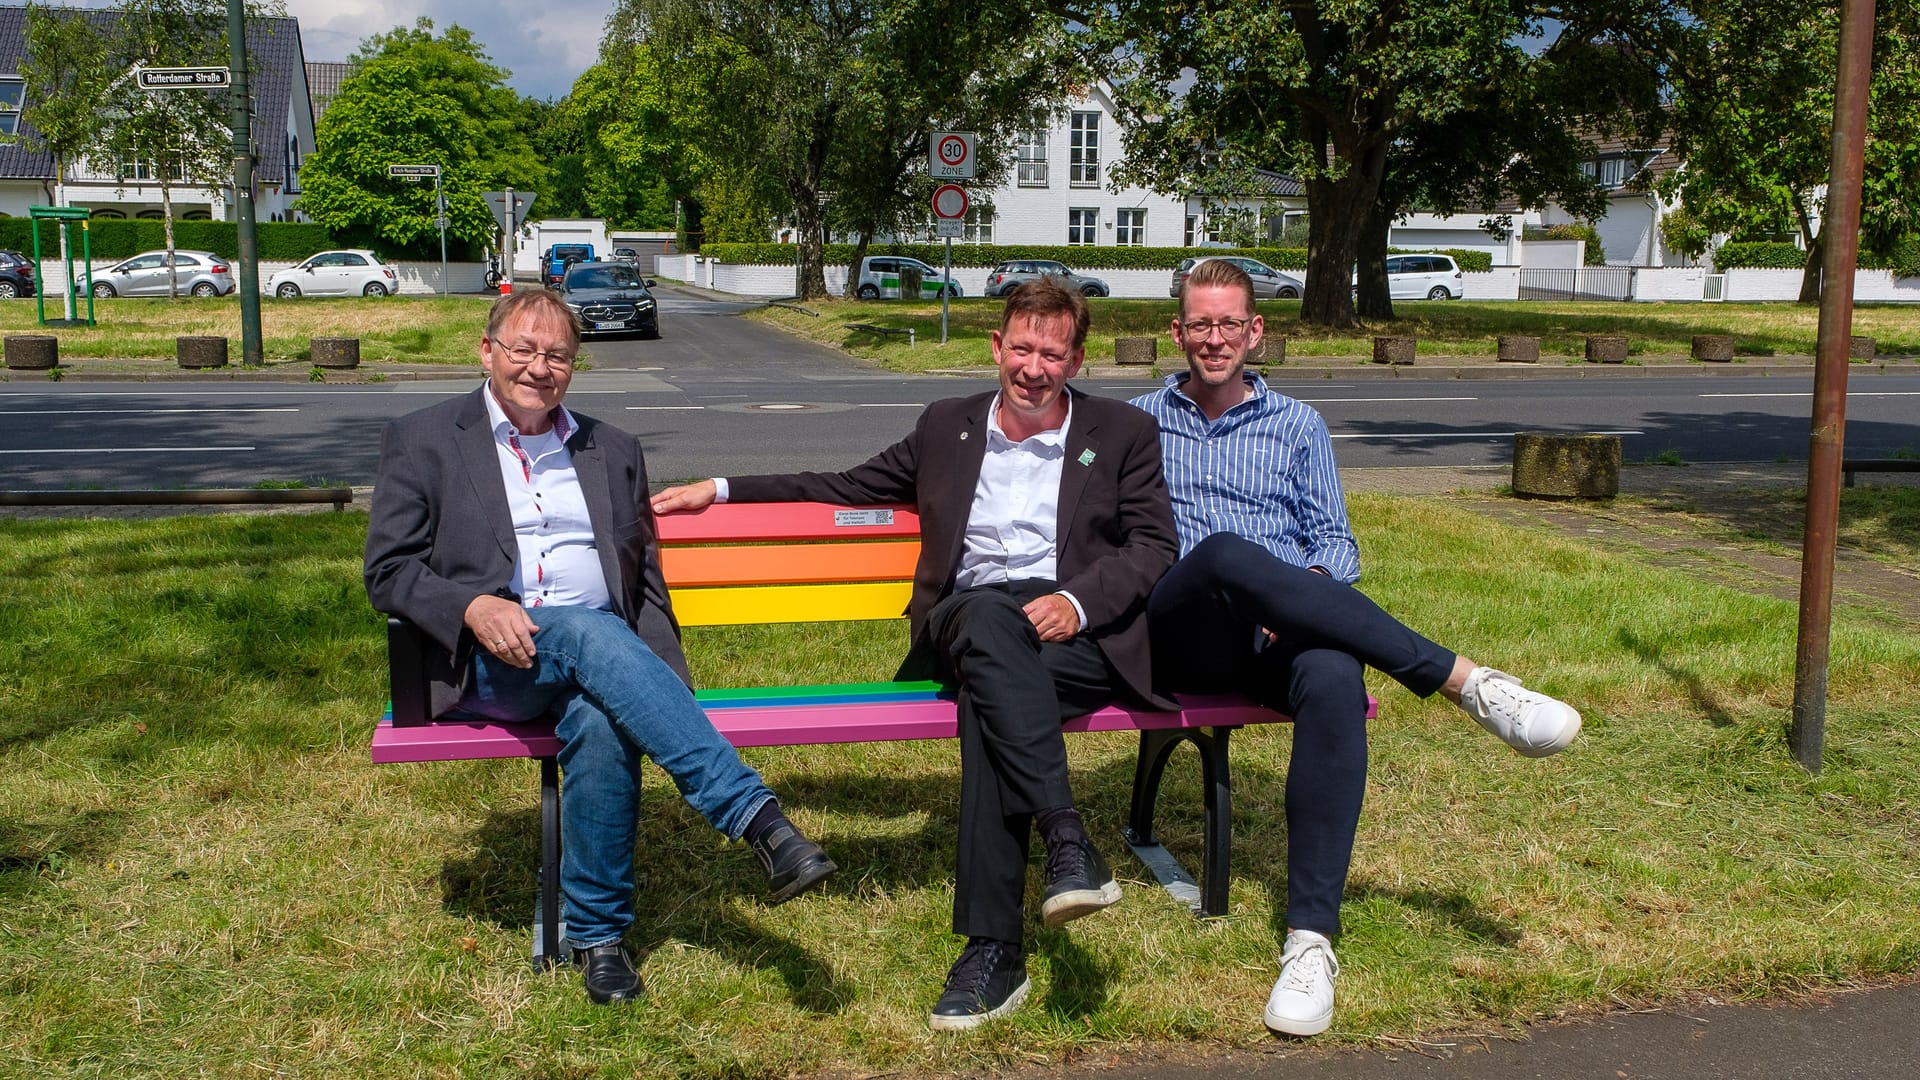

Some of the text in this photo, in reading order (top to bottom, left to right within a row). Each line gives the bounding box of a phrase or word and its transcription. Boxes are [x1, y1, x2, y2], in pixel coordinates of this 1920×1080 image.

[147, 72, 220, 83] Rotterdamer Straße
[944, 143, 961, 157] 30
[941, 167, 964, 176] ZONE
